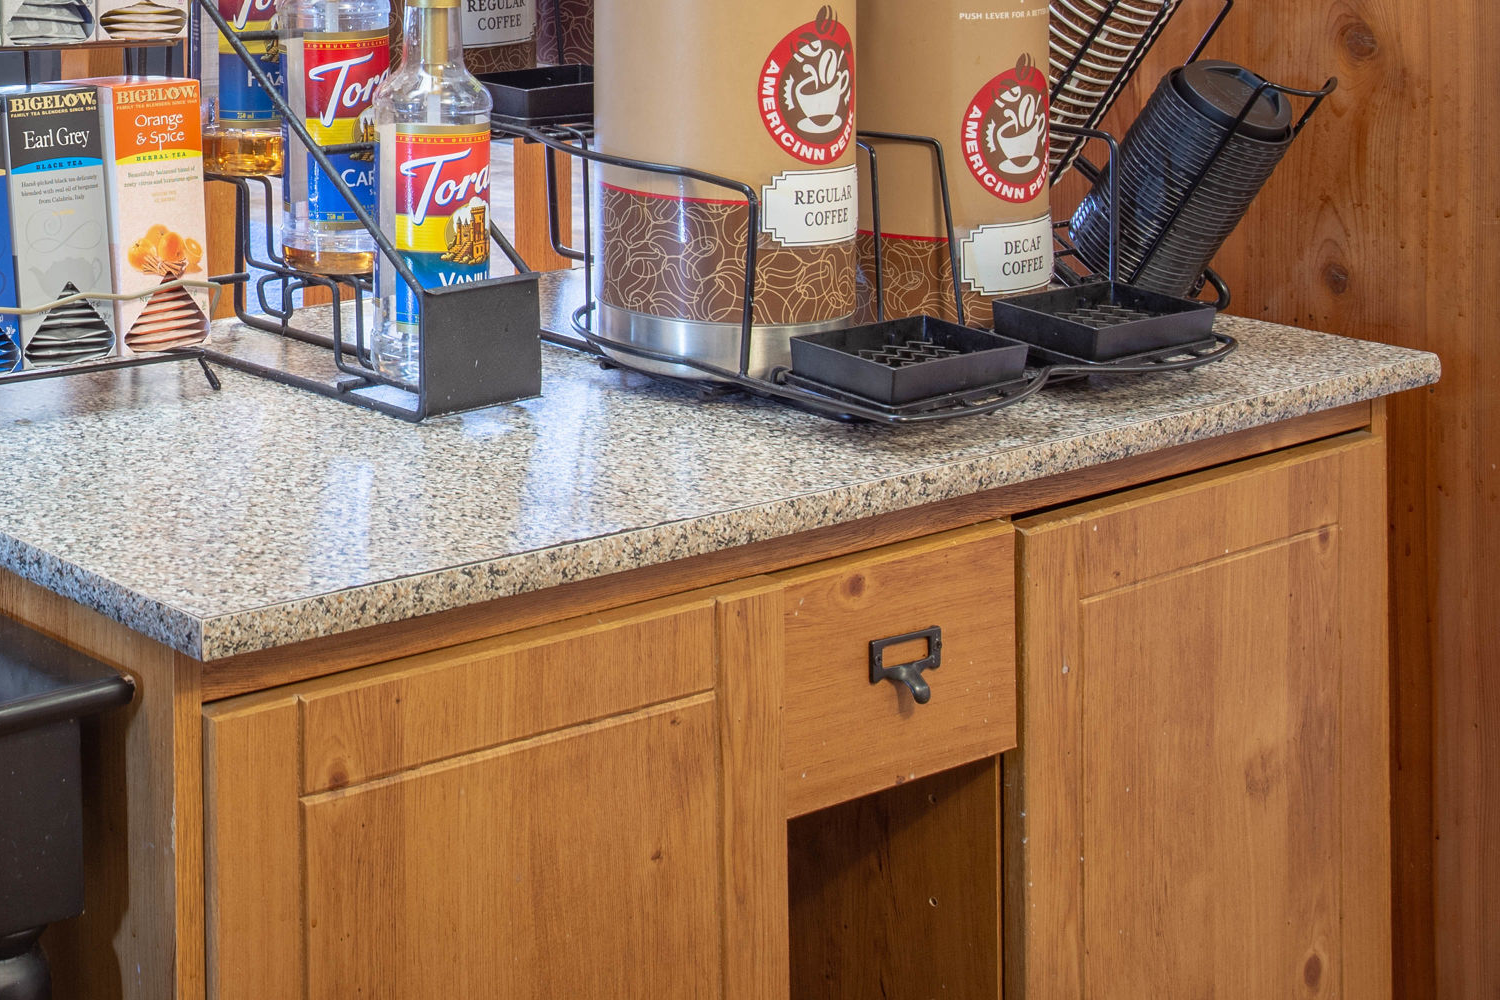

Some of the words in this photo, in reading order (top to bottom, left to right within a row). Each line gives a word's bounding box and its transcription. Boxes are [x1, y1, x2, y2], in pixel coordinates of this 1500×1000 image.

[478, 13, 522, 31] COFFEE
[959, 12, 983, 20] PUSH
[985, 12, 1010, 20] LEVER
[10, 92, 95, 112] BIGELOW
[116, 85, 197, 104] BIGELOW
[762, 59, 826, 161] AMERICINN
[830, 110, 854, 158] PERK
[135, 113, 183, 131] Orange
[22, 129, 54, 150] Earl
[56, 127, 90, 148] Grey
[136, 133, 147, 146] &
[150, 131, 184, 151] Spice
[965, 104, 1025, 200] AMERICINN
[794, 184, 852, 206] REGULAR
[804, 208, 848, 228] COFFEE
[1004, 235, 1042, 256] DECAF
[1002, 255, 1044, 276] COFFEE
